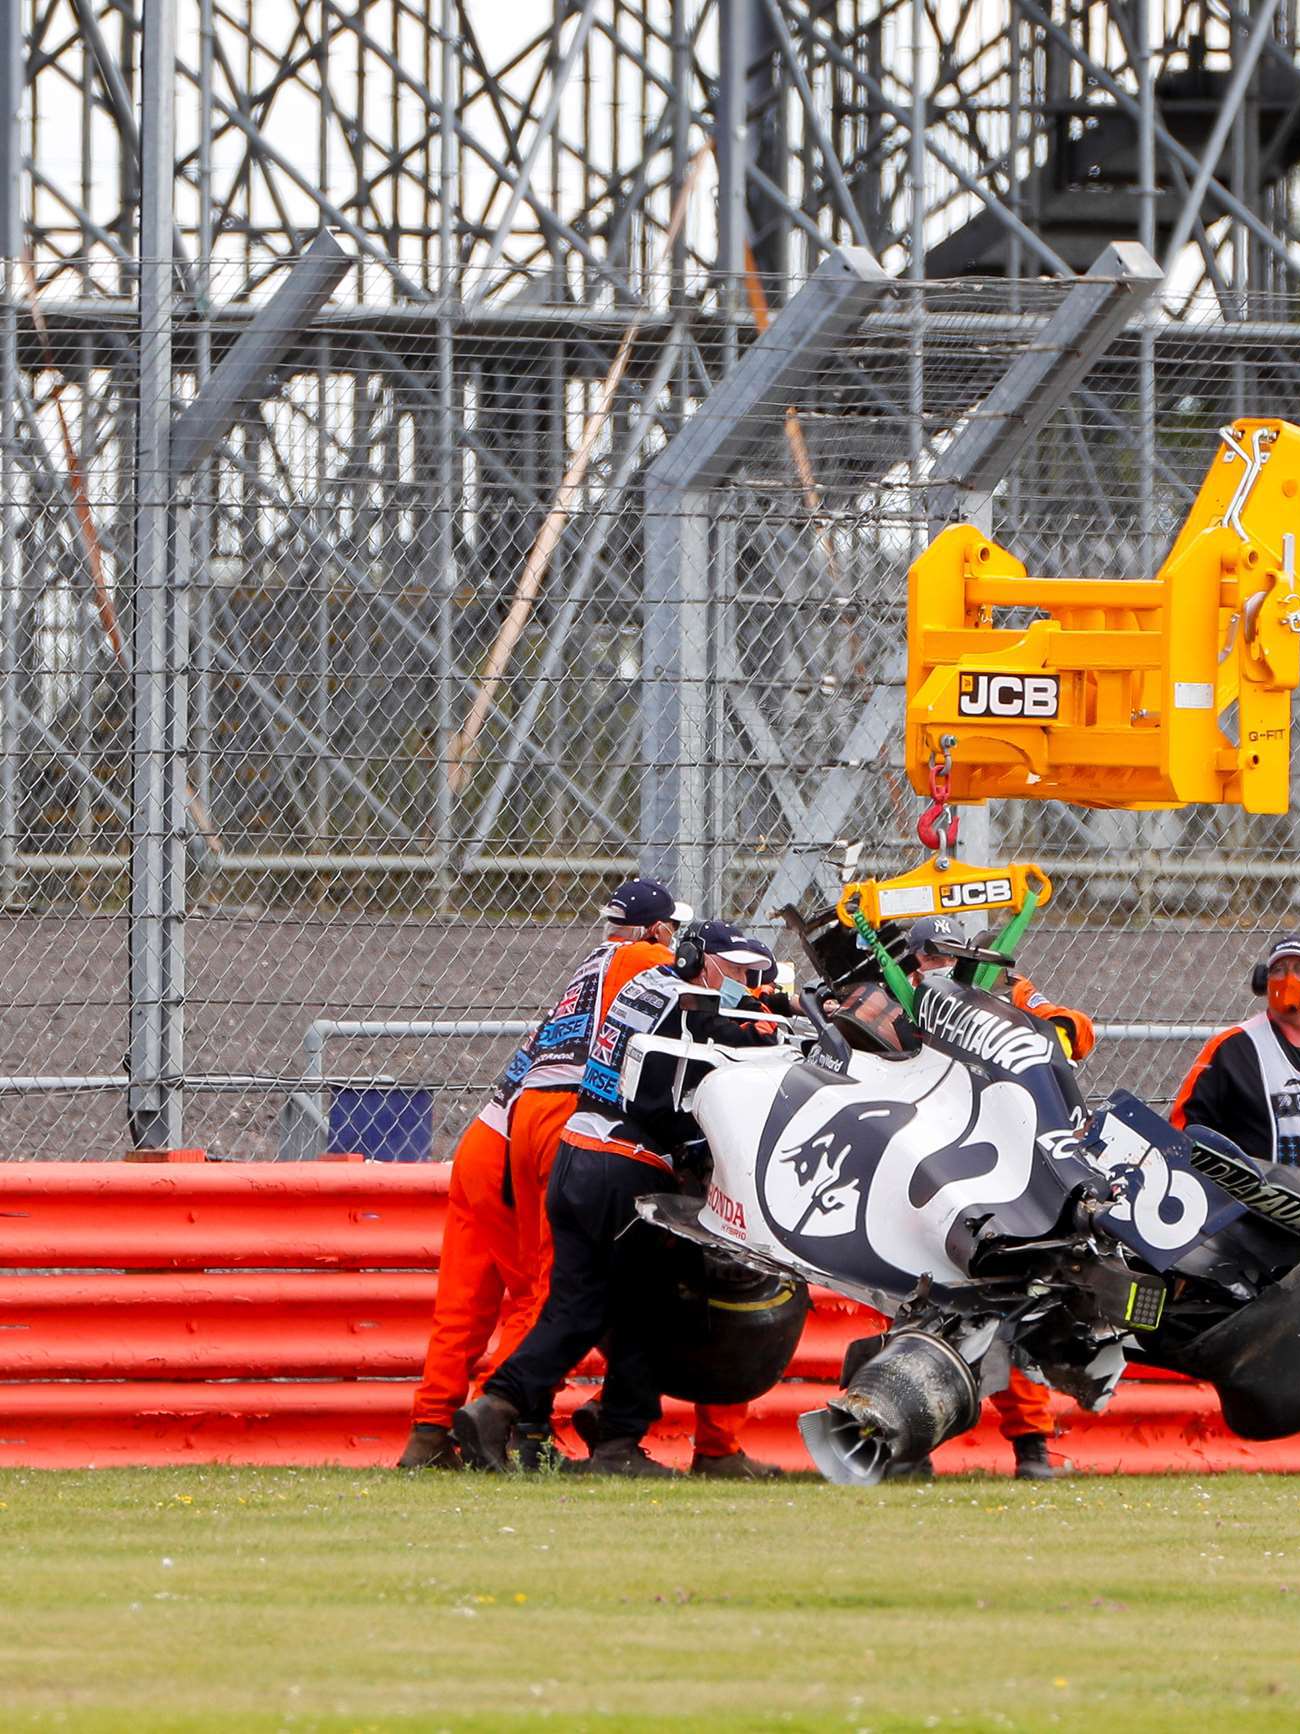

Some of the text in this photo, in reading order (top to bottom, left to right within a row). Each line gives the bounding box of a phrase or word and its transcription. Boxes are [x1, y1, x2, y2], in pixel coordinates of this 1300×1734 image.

[960, 674, 1059, 717] JCB
[941, 878, 1012, 908] JCB
[918, 987, 1055, 1076] ALPHATAURI
